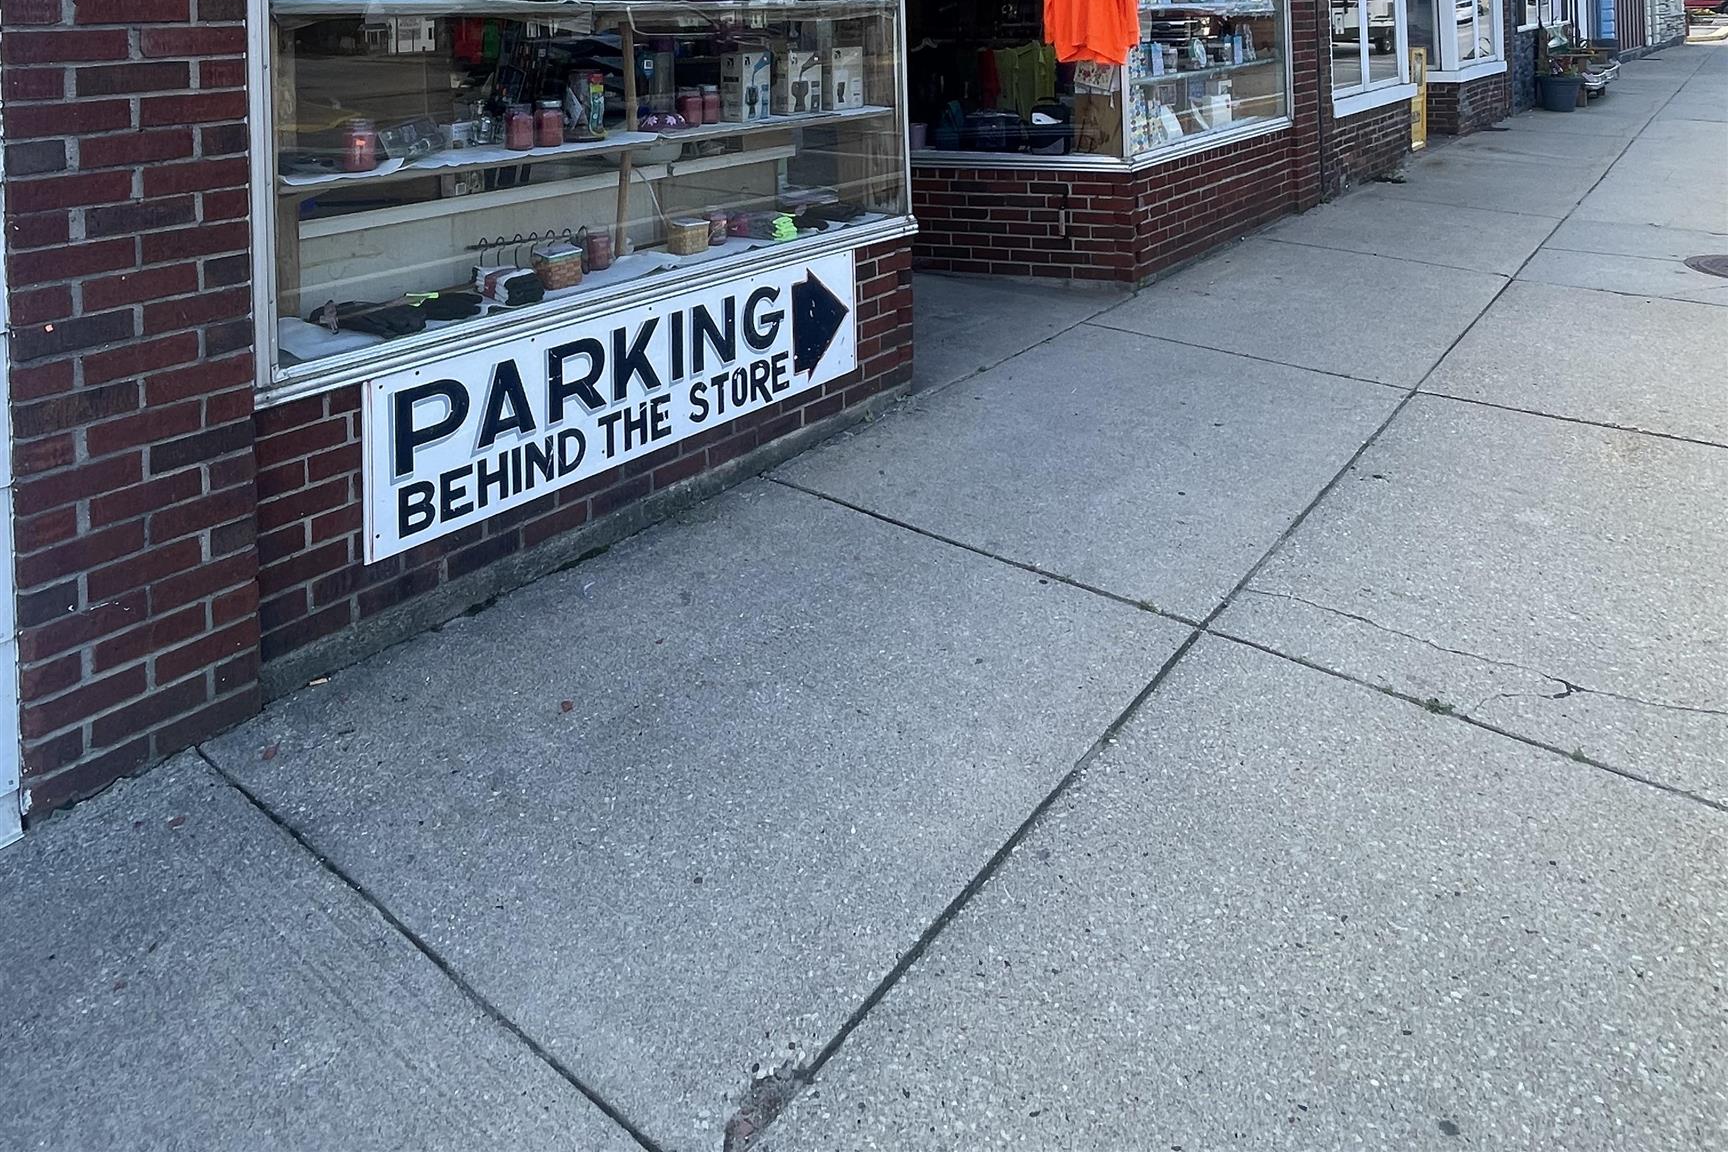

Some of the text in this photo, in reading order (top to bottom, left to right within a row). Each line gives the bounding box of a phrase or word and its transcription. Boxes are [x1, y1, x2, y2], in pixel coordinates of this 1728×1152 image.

[391, 285, 785, 482] PARKING
[398, 351, 790, 540] BEHIND THE STORE
